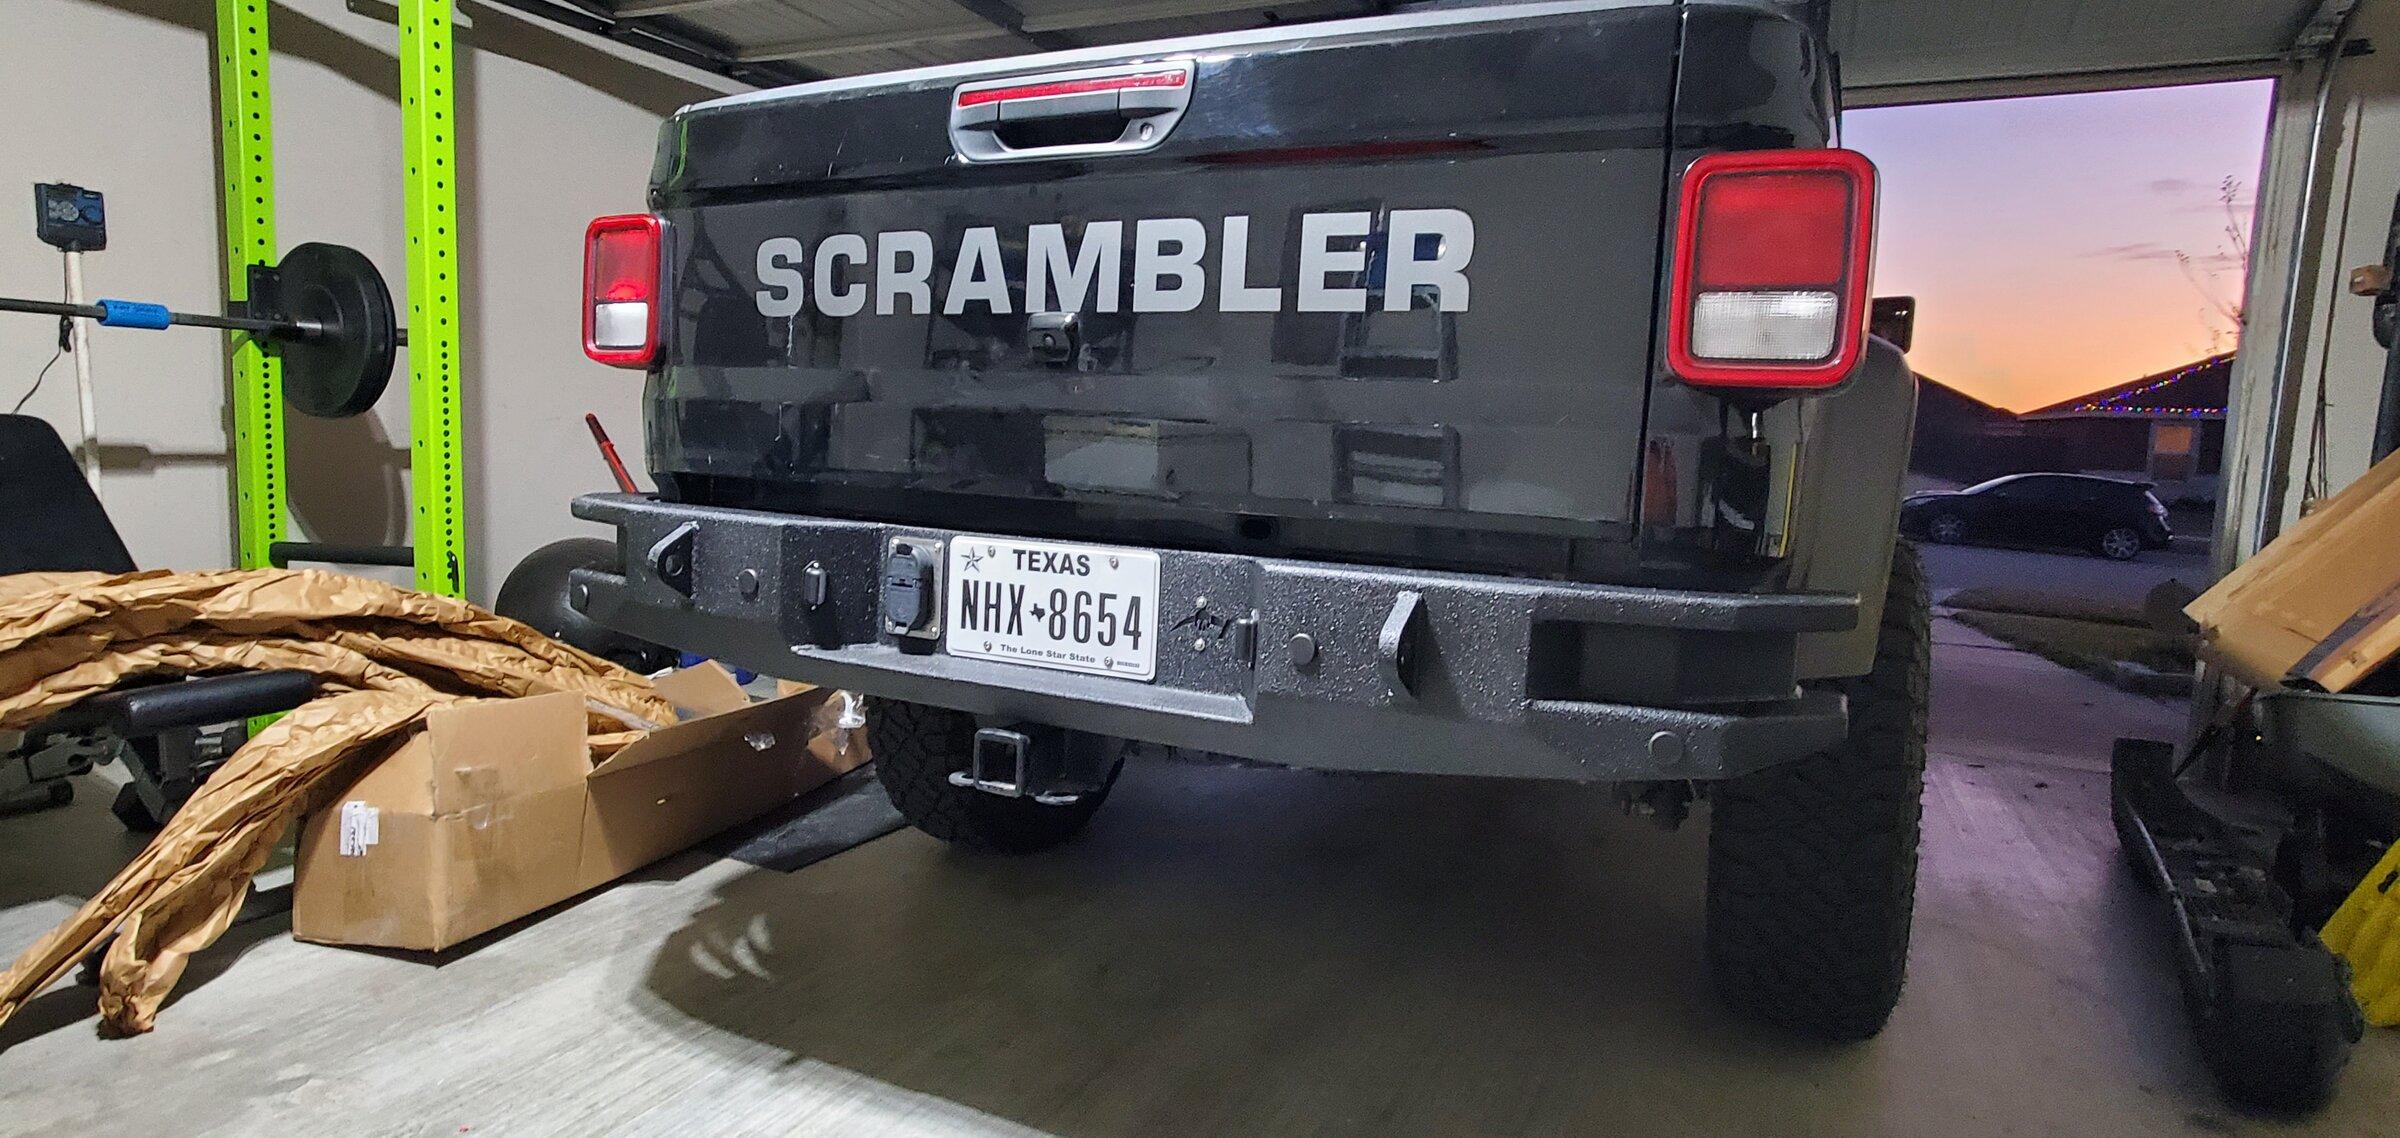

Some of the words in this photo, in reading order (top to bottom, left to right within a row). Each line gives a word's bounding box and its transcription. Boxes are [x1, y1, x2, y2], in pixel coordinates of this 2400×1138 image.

[755, 208, 1476, 318] SCRAMBLER
[1013, 549, 1091, 577] TEXAS
[1000, 643, 1018, 654] The
[1020, 646, 1044, 657] Lone
[1046, 650, 1067, 660] Star
[1069, 652, 1096, 664] State
